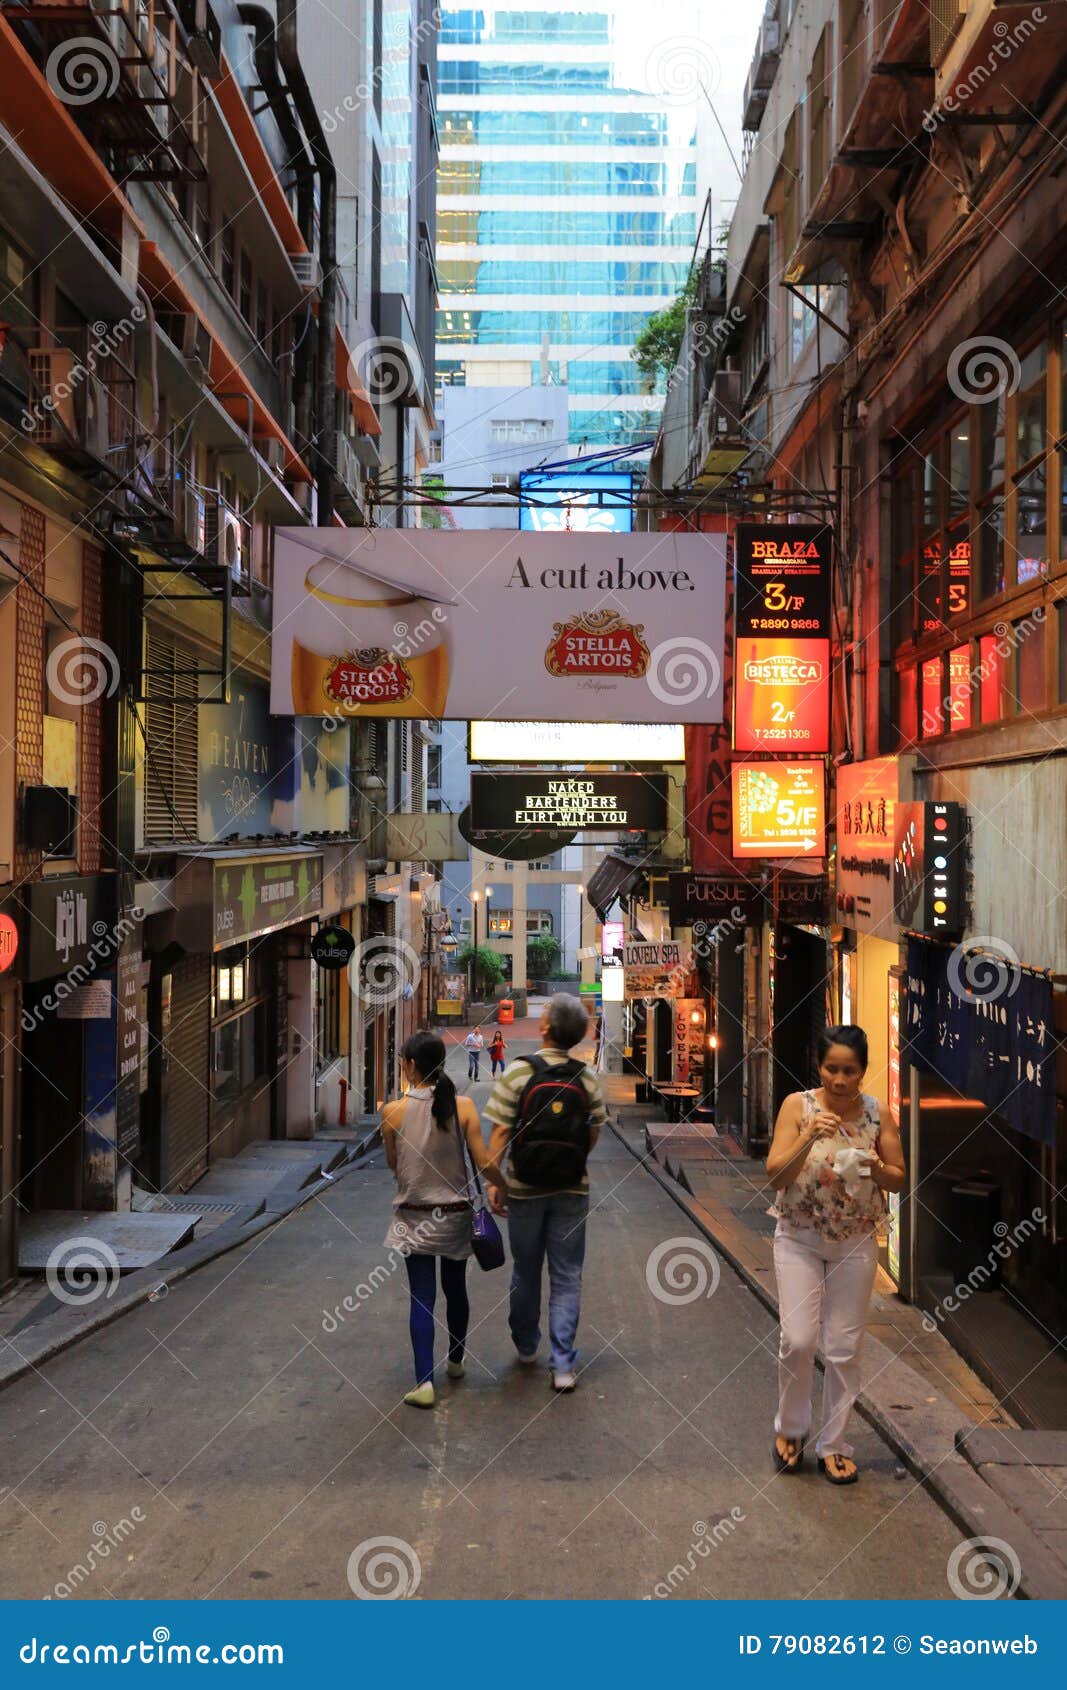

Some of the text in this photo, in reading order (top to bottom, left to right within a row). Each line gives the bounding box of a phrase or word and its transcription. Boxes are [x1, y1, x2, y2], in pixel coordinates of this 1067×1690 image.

[751, 541, 820, 558] BRAZA
[504, 556, 695, 592] A cut above.
[764, 583, 805, 611] 3/F
[750, 618, 820, 629] T 2890 9268
[565, 637, 632, 652] STELLA
[564, 653, 632, 667] ARTOIS
[339, 671, 398, 684] STELLA
[748, 665, 818, 679] BISTECCA
[339, 684, 399, 697] ARTOIS
[771, 701, 796, 723] 2/F
[754, 729, 761, 738] T
[763, 729, 786, 739] 2525
[208, 730, 269, 774] HEAVEN
[548, 782, 594, 794] NAKED
[526, 796, 617, 808] BARTENDERS
[515, 811, 627, 823] FLIRT WITH YOU
[776, 799, 817, 826] 5/F
[686, 883, 746, 901] PURSUE
[316, 945, 348, 960] pulse
[626, 945, 660, 966] LOVELY
[661, 943, 681, 964] SPA
[125, 980, 136, 997] ALL
[676, 1014, 688, 1072] LOVELY
